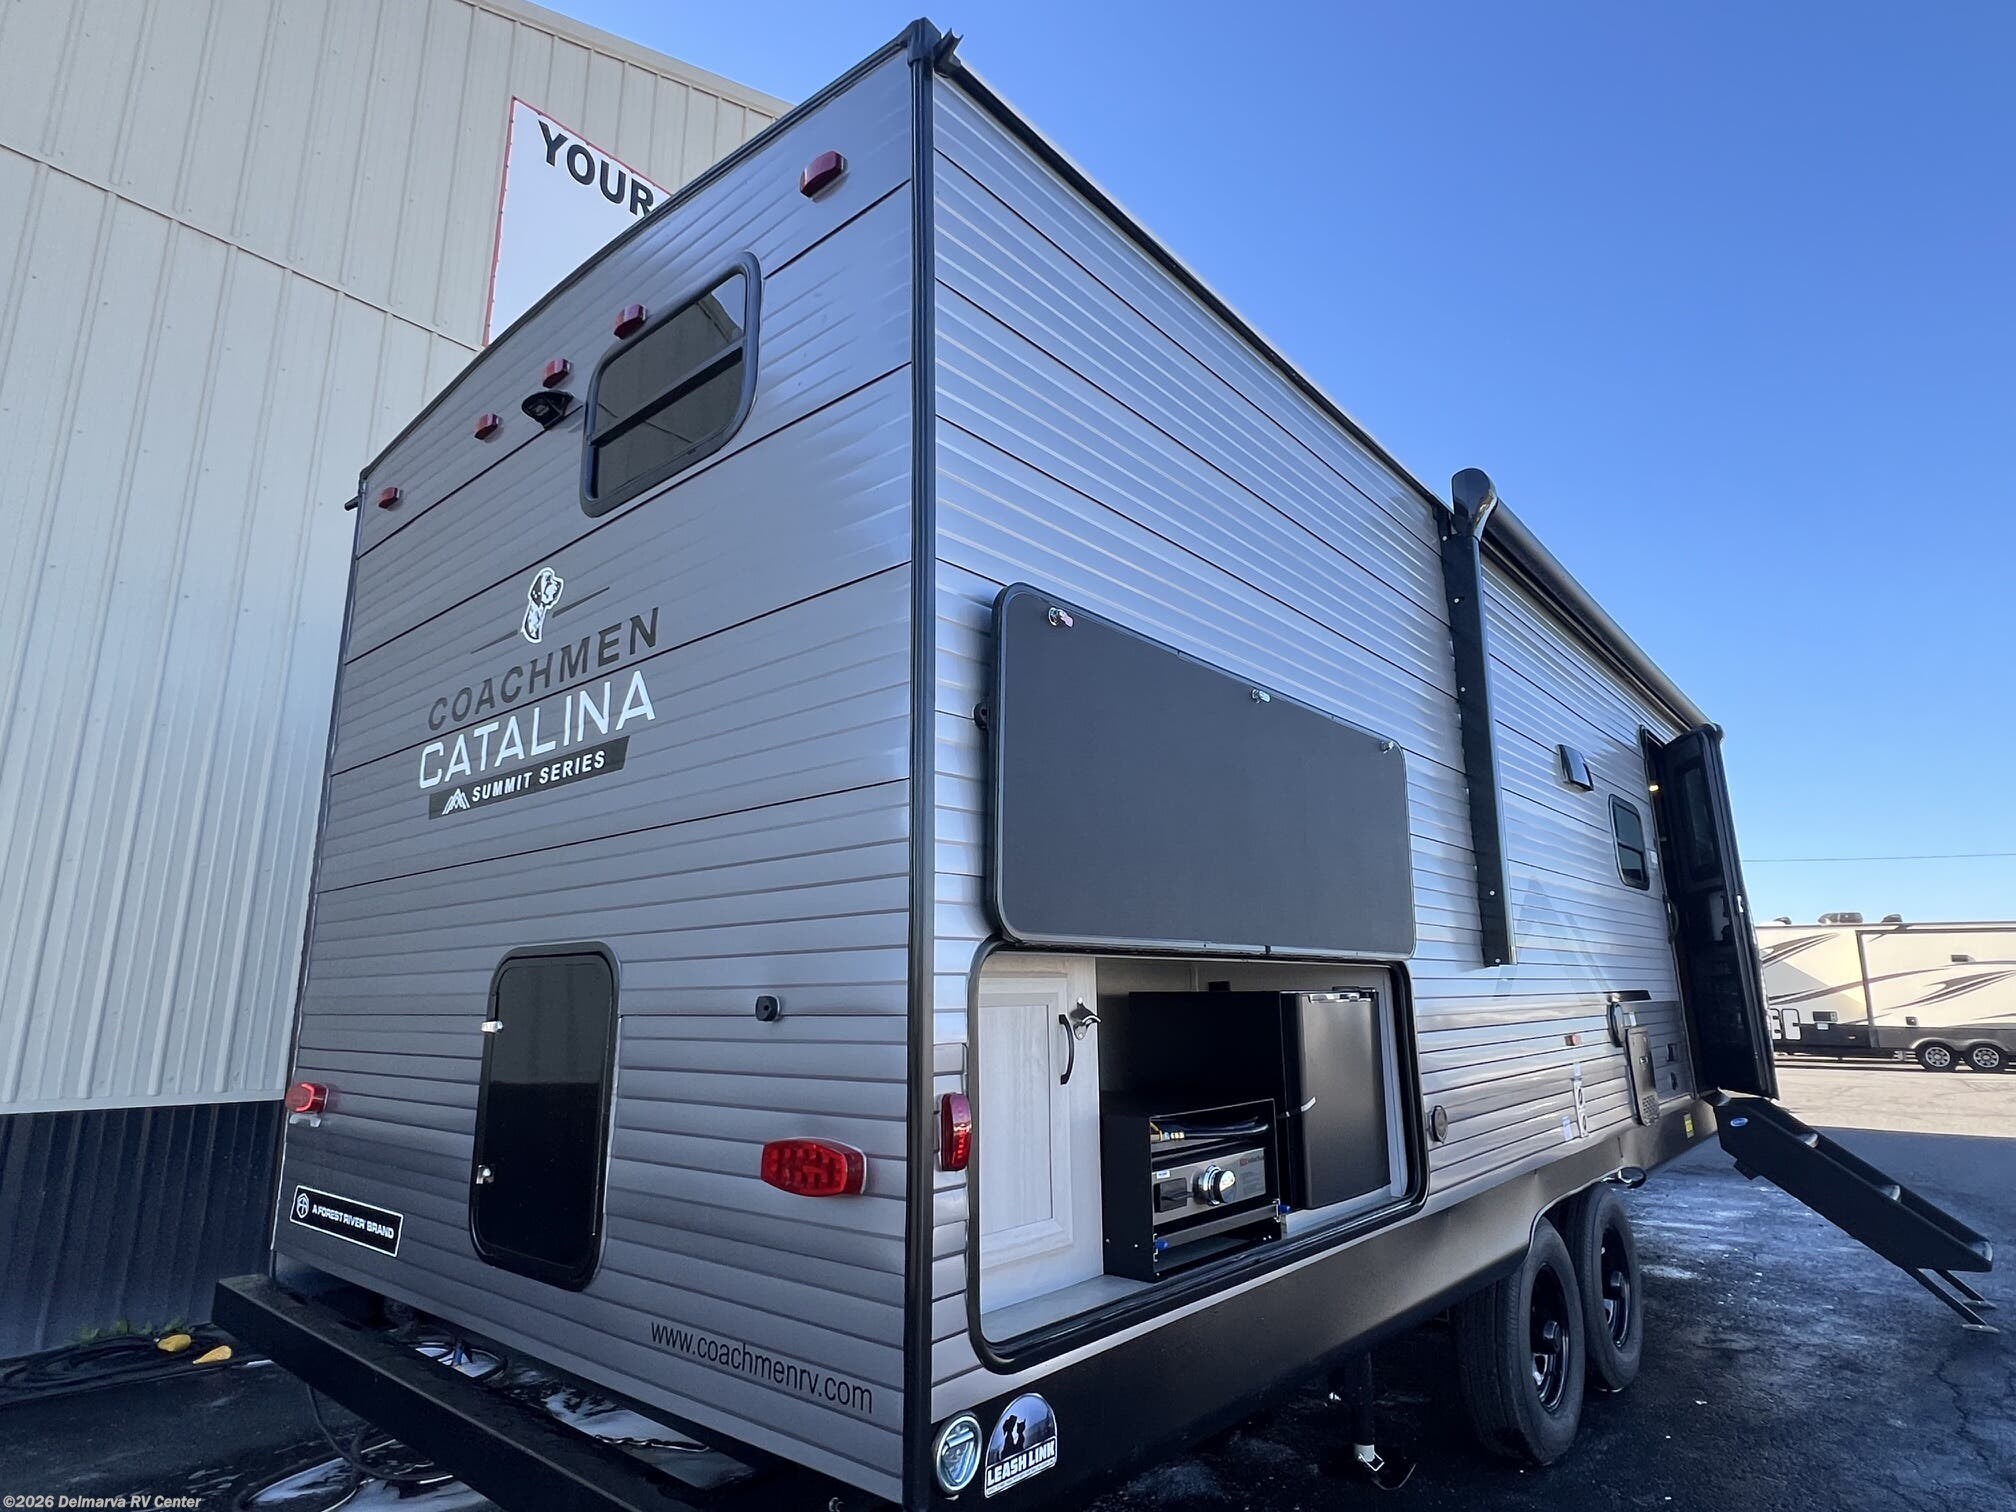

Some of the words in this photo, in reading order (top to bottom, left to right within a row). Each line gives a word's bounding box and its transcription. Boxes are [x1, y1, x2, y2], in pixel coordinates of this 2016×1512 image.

[538, 119, 654, 217] YOUR
[428, 606, 659, 731] COACHMEN
[419, 670, 656, 789] CATALINA
[472, 771, 533, 802] SUMMIT
[539, 750, 606, 784] SERIES
[312, 1204, 318, 1215] A
[318, 1206, 343, 1223] FOREST
[343, 1213, 366, 1230] RIVER
[366, 1220, 395, 1239] BRAND
[651, 1322, 872, 1414] www.coachmenrv.com
[987, 1453, 1027, 1487] LEASH
[1028, 1440, 1055, 1467] LINK
